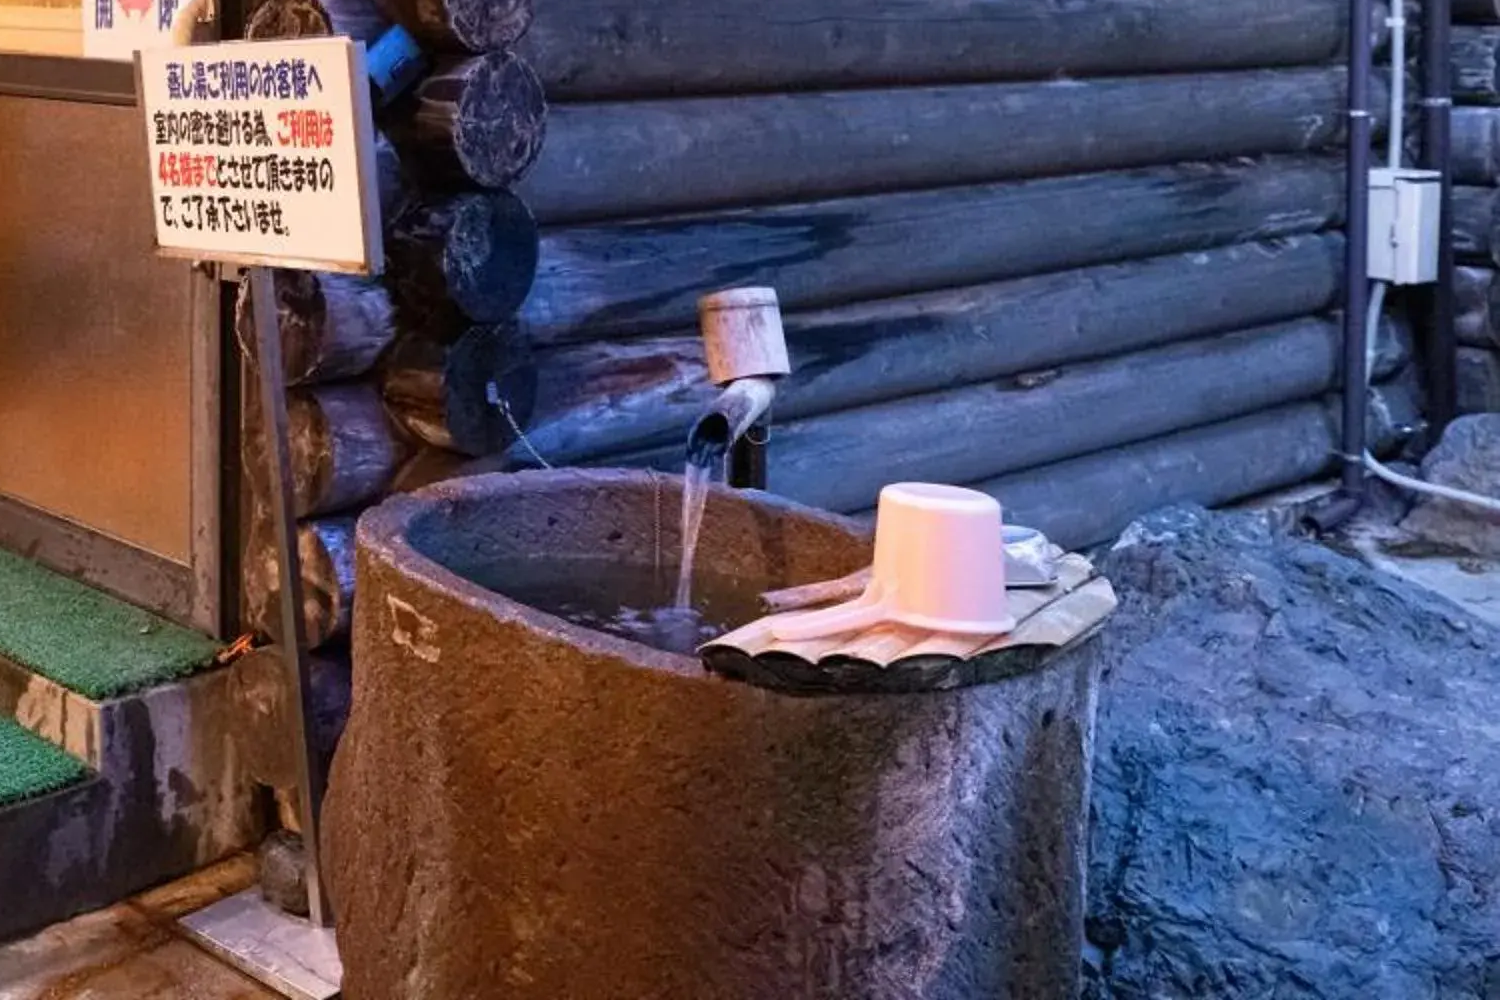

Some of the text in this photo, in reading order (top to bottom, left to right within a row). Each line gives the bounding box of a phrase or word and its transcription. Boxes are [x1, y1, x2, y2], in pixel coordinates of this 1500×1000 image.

[166, 58, 323, 100] 蒸し湯ご利用のお客様へ
[158, 151, 335, 193] 4名様までとさせて頂きますの
[160, 195, 290, 236] で、ご了承下さいませ。
